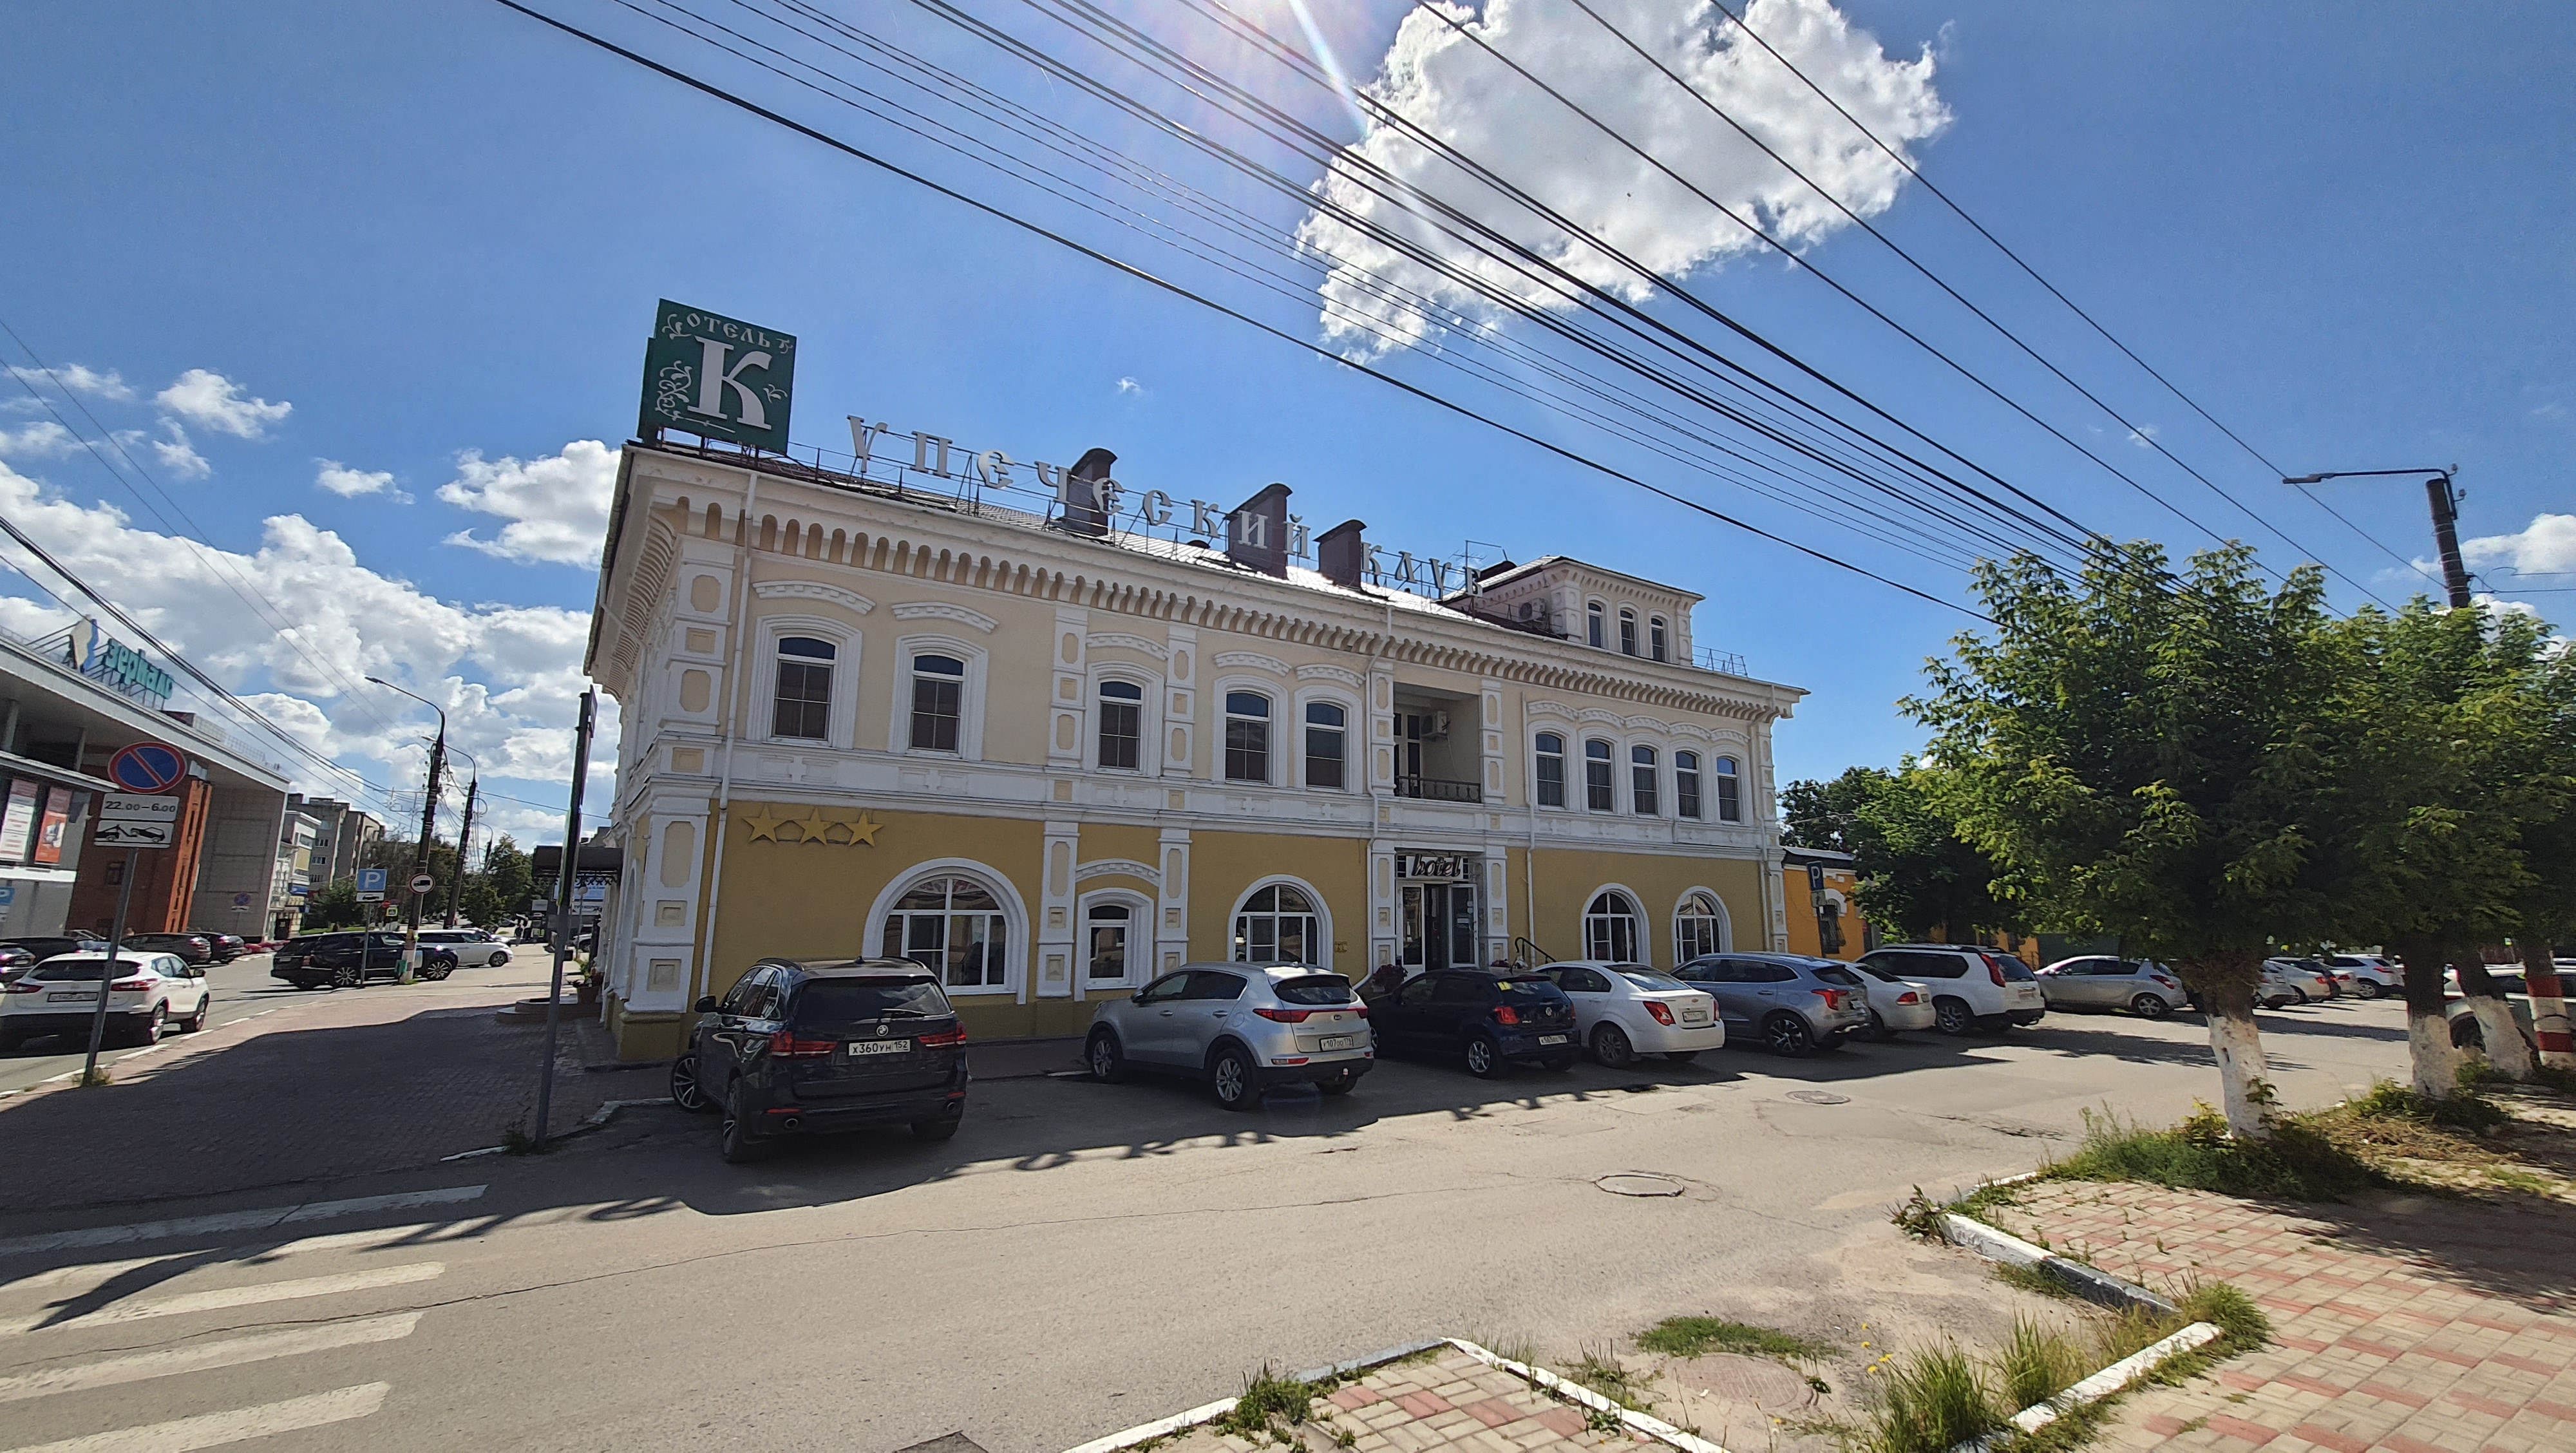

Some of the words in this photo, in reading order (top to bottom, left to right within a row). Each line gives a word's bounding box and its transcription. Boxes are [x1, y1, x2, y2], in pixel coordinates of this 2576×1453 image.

[687, 313, 771, 348] ОТЕЛЬ
[1412, 853, 1461, 877] hotel
[365, 871, 381, 889] P
[1811, 866, 1821, 888] P
[894, 1041, 907, 1049] 152
